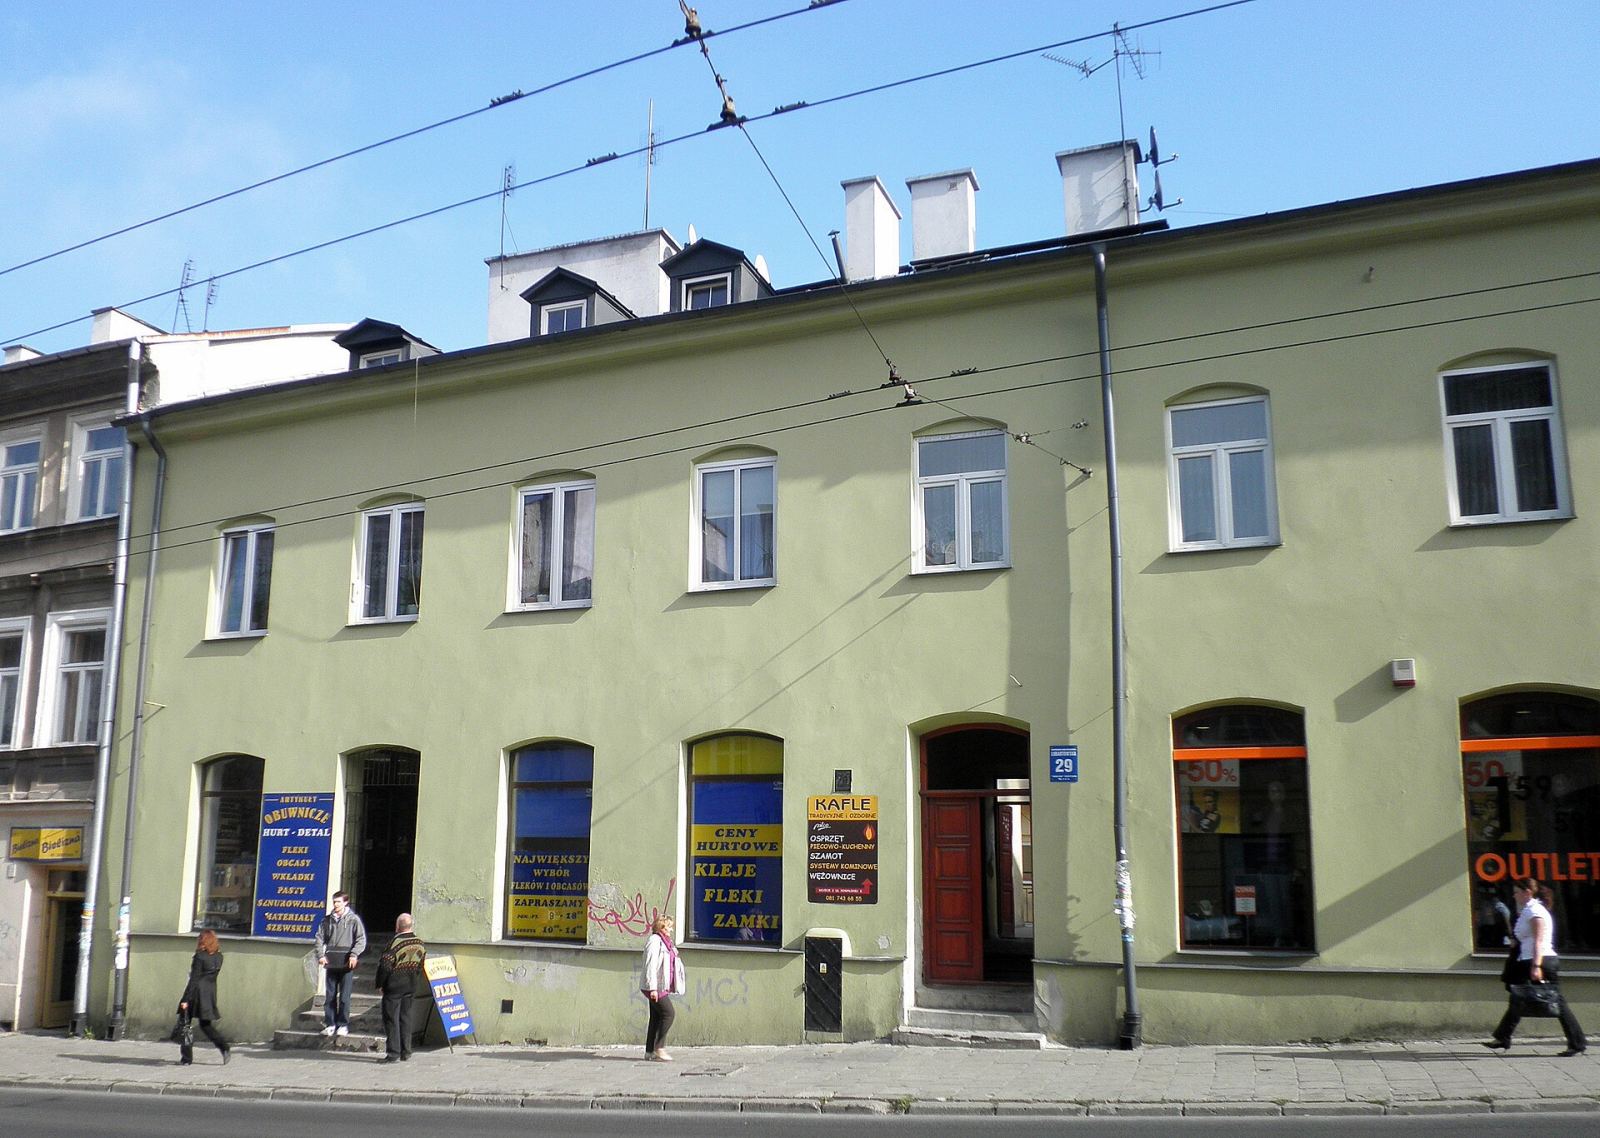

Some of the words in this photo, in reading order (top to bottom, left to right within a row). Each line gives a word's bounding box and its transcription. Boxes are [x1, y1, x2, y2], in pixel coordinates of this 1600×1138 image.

[1055, 758, 1073, 773] 29
[815, 798, 871, 811] KAFLE
[264, 806, 331, 824] OBUWNICZE
[262, 828, 290, 837] HURT
[297, 828, 331, 837] DETAL
[715, 828, 758, 838] CENY
[41, 835, 81, 853] Bielizna
[810, 835, 845, 843] OSPRZĘT
[281, 846, 309, 854] FLEKI
[696, 841, 779, 851] HURTOWE
[513, 855, 589, 866] NAJWIĘKSZY
[810, 852, 843, 860] SZAMOT
[276, 859, 312, 867] OBCASY
[533, 866, 570, 877] WYBÓR
[694, 863, 757, 878] KLEJE
[810, 872, 856, 880] WĘŻOWNICE
[511, 879, 544, 890] FLEKÓW
[277, 886, 305, 894] PASTY
[703, 888, 764, 904] FLEKI
[256, 899, 325, 908] SZNUROWADŁA
[514, 898, 585, 908] ZAPRASZAMY
[713, 913, 780, 929] ZAMKI
[266, 923, 312, 933] SZEWSKIE
[433, 982, 460, 998] FLEKI
